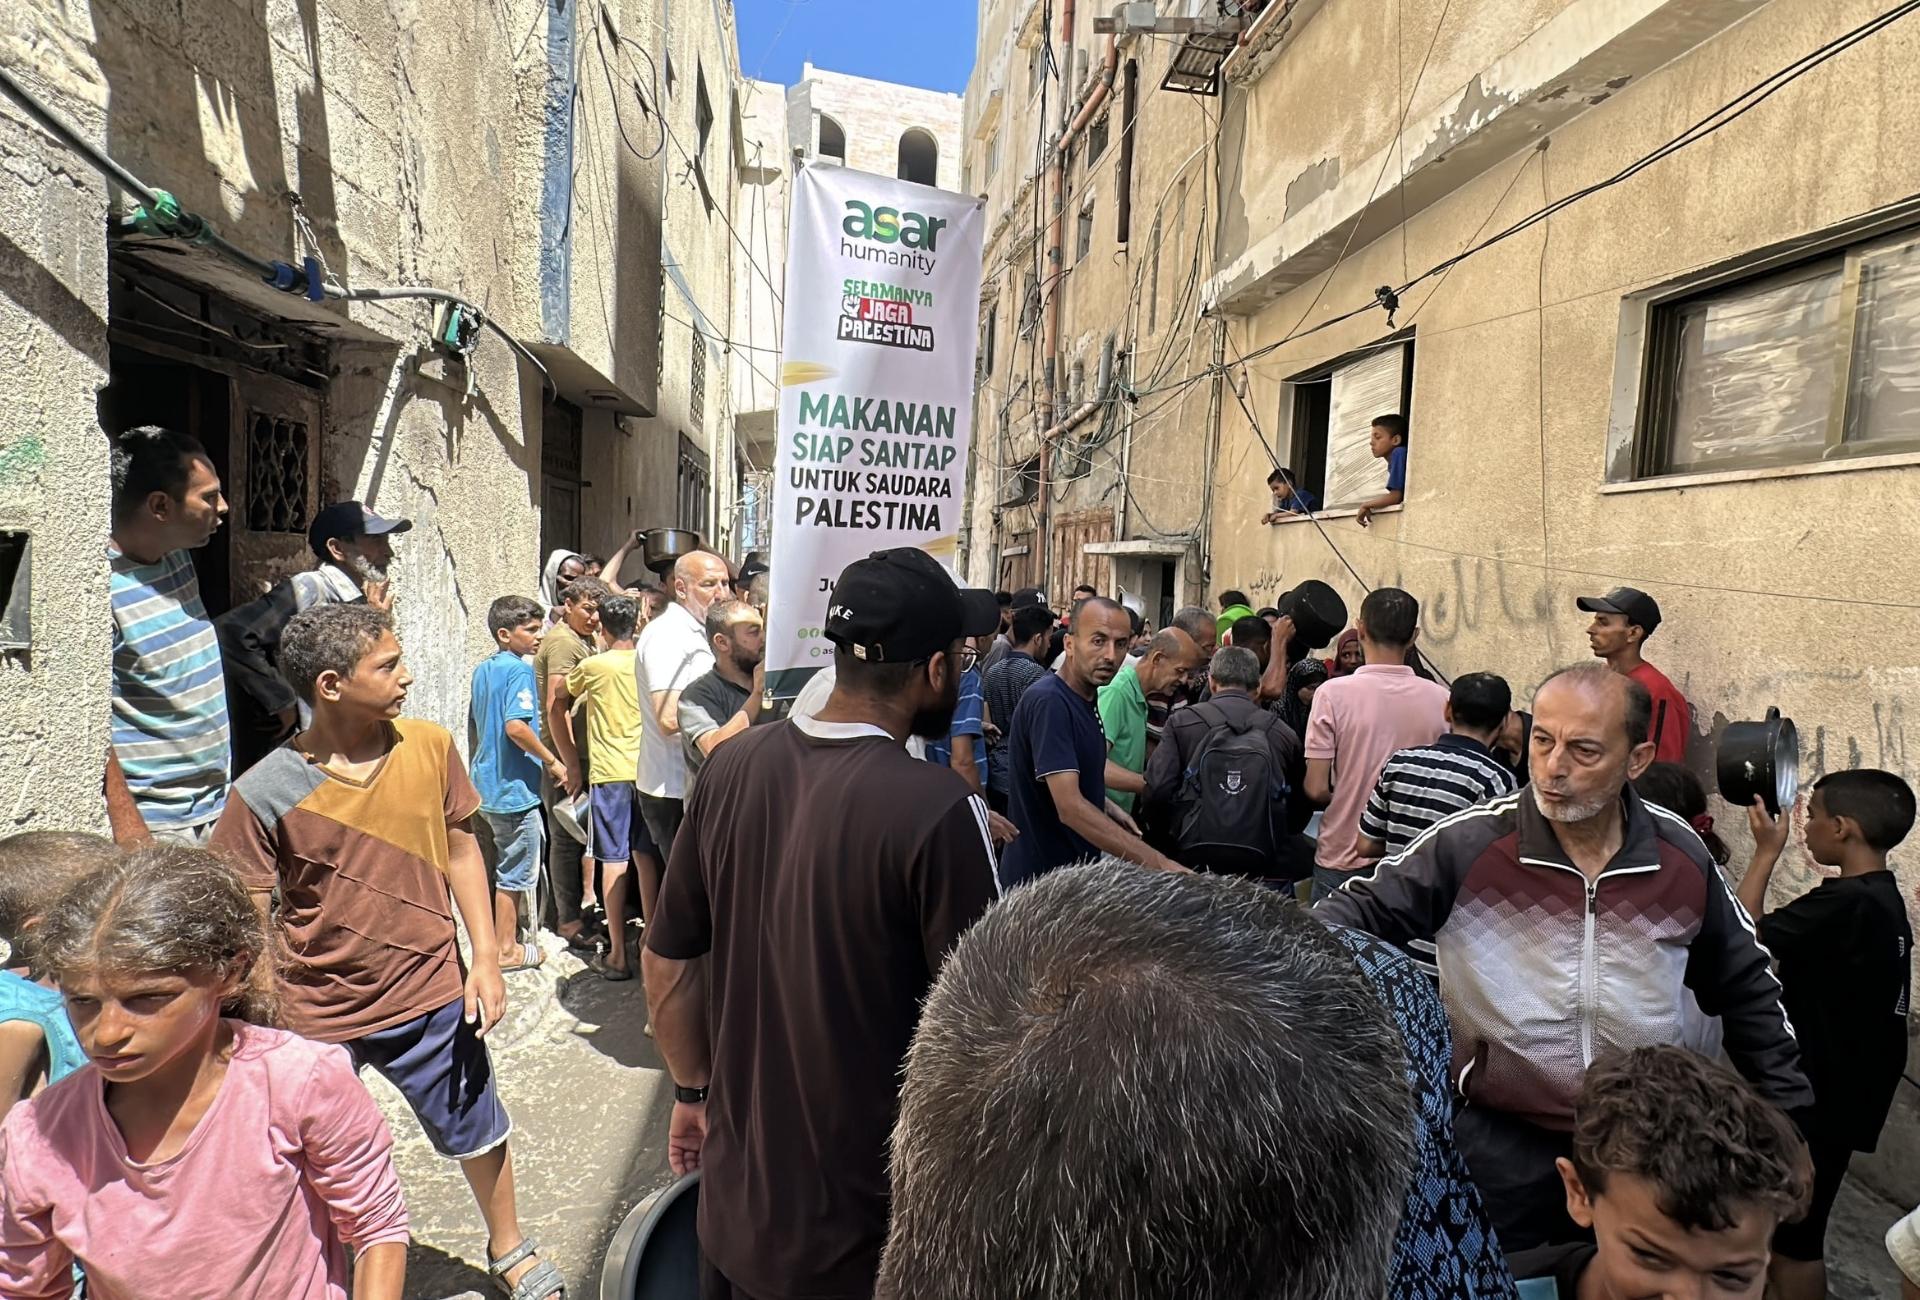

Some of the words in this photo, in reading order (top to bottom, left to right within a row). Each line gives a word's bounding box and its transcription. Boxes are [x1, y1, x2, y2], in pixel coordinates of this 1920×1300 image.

[842, 200, 947, 252] asar
[841, 237, 936, 276] humanity
[843, 279, 932, 307] SELAMANYA
[863, 299, 909, 324] JAGA
[840, 316, 932, 348] PALESTINA
[798, 391, 957, 440] MAKANAN
[791, 432, 855, 464] SIAP
[859, 438, 957, 471] SANTAP
[790, 466, 862, 493] UNTUK
[865, 473, 952, 498] SAUDARA
[796, 496, 942, 532] PALESTINA
